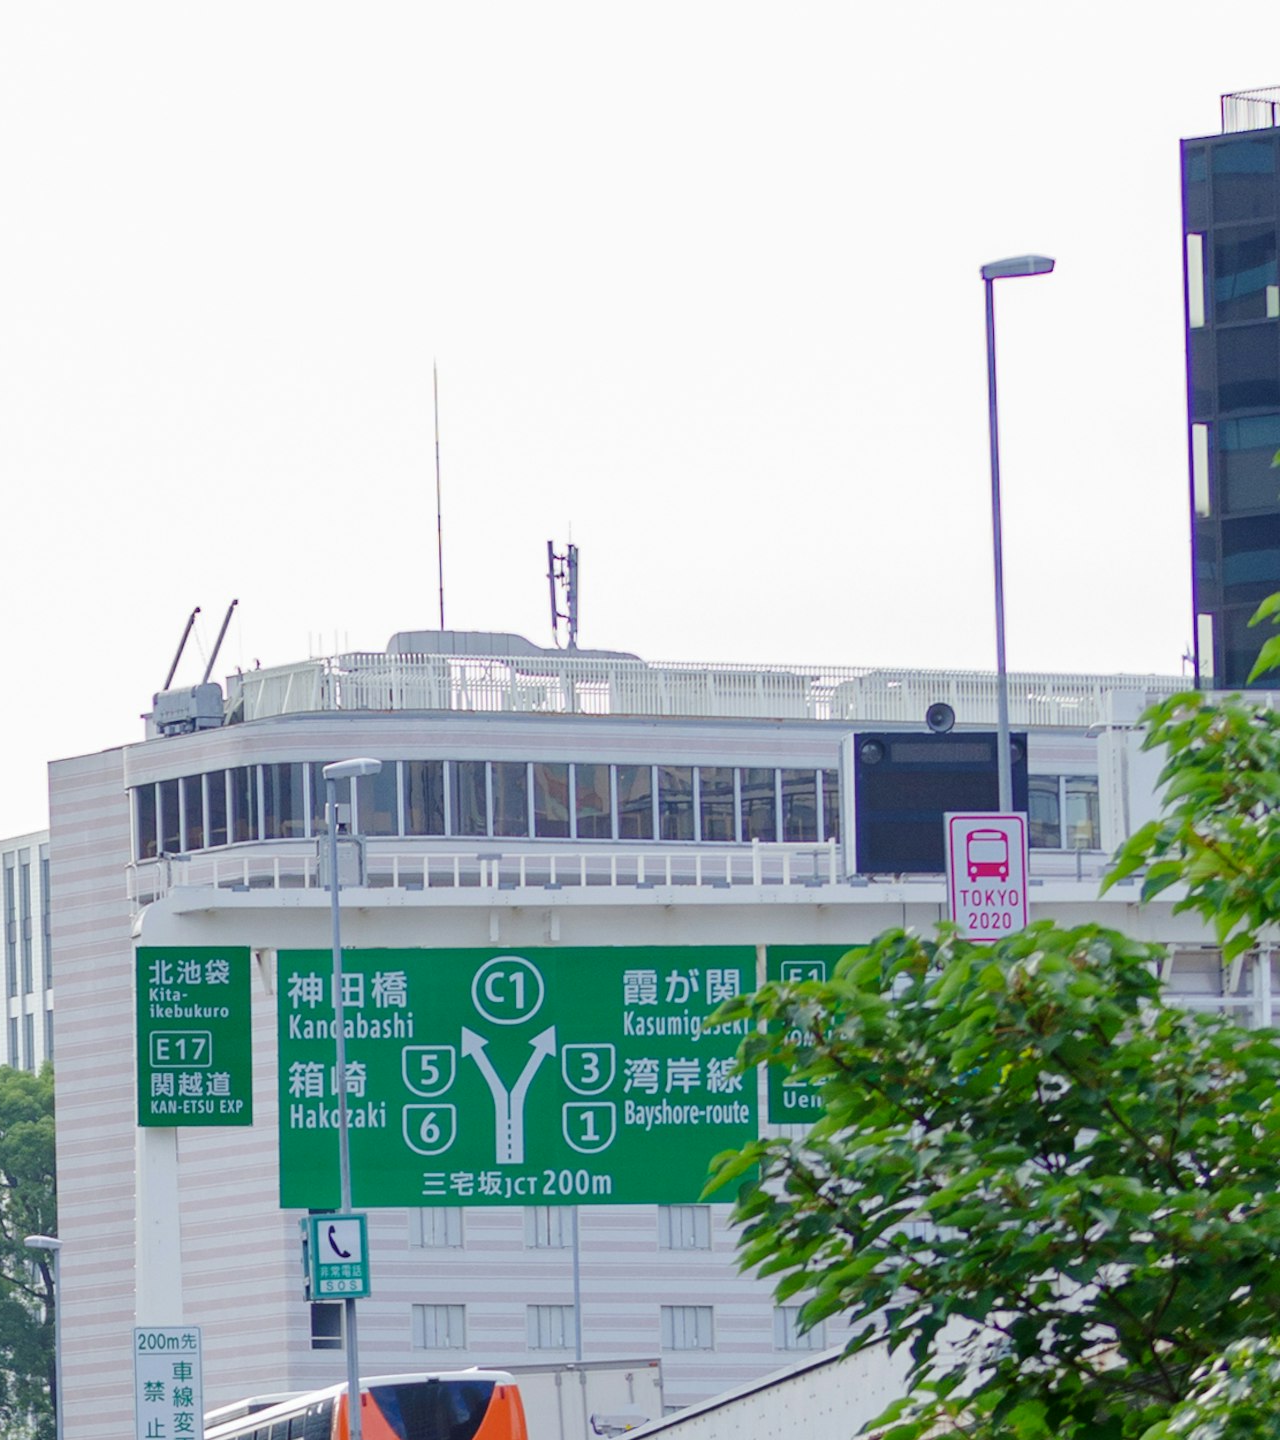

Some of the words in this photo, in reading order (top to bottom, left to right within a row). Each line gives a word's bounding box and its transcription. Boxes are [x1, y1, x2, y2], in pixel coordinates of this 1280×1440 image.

[960, 889, 1020, 907] TOKYO
[968, 912, 1012, 930] 2020
[148, 959, 230, 985] 北池袋
[149, 988, 188, 1002] Kita-
[288, 971, 408, 1009] 神田橋
[484, 971, 525, 1010] C1
[623, 968, 741, 1006] 霞が関
[150, 1004, 230, 1019] ikebukuro
[156, 1038, 206, 1061] E17
[288, 1061, 367, 1098] 箱崎
[420, 1054, 440, 1086] 5
[580, 1052, 600, 1084] 3
[623, 1057, 743, 1094] 湾岸線
[151, 1071, 231, 1098] 関越道
[151, 1100, 214, 1114] KAN-ETSU
[220, 1099, 244, 1114] EXP
[783, 1090, 824, 1109] Uen
[290, 1101, 386, 1129] Hakozaki
[419, 1111, 441, 1144] 6
[579, 1110, 600, 1141] 1
[624, 1098, 750, 1131] Bayshore-route
[542, 1169, 613, 1196] 200m
[326, 1280, 357, 1292] SOS
[137, 1333, 197, 1350] 200m先
[144, 1380, 167, 1440] 禁止
